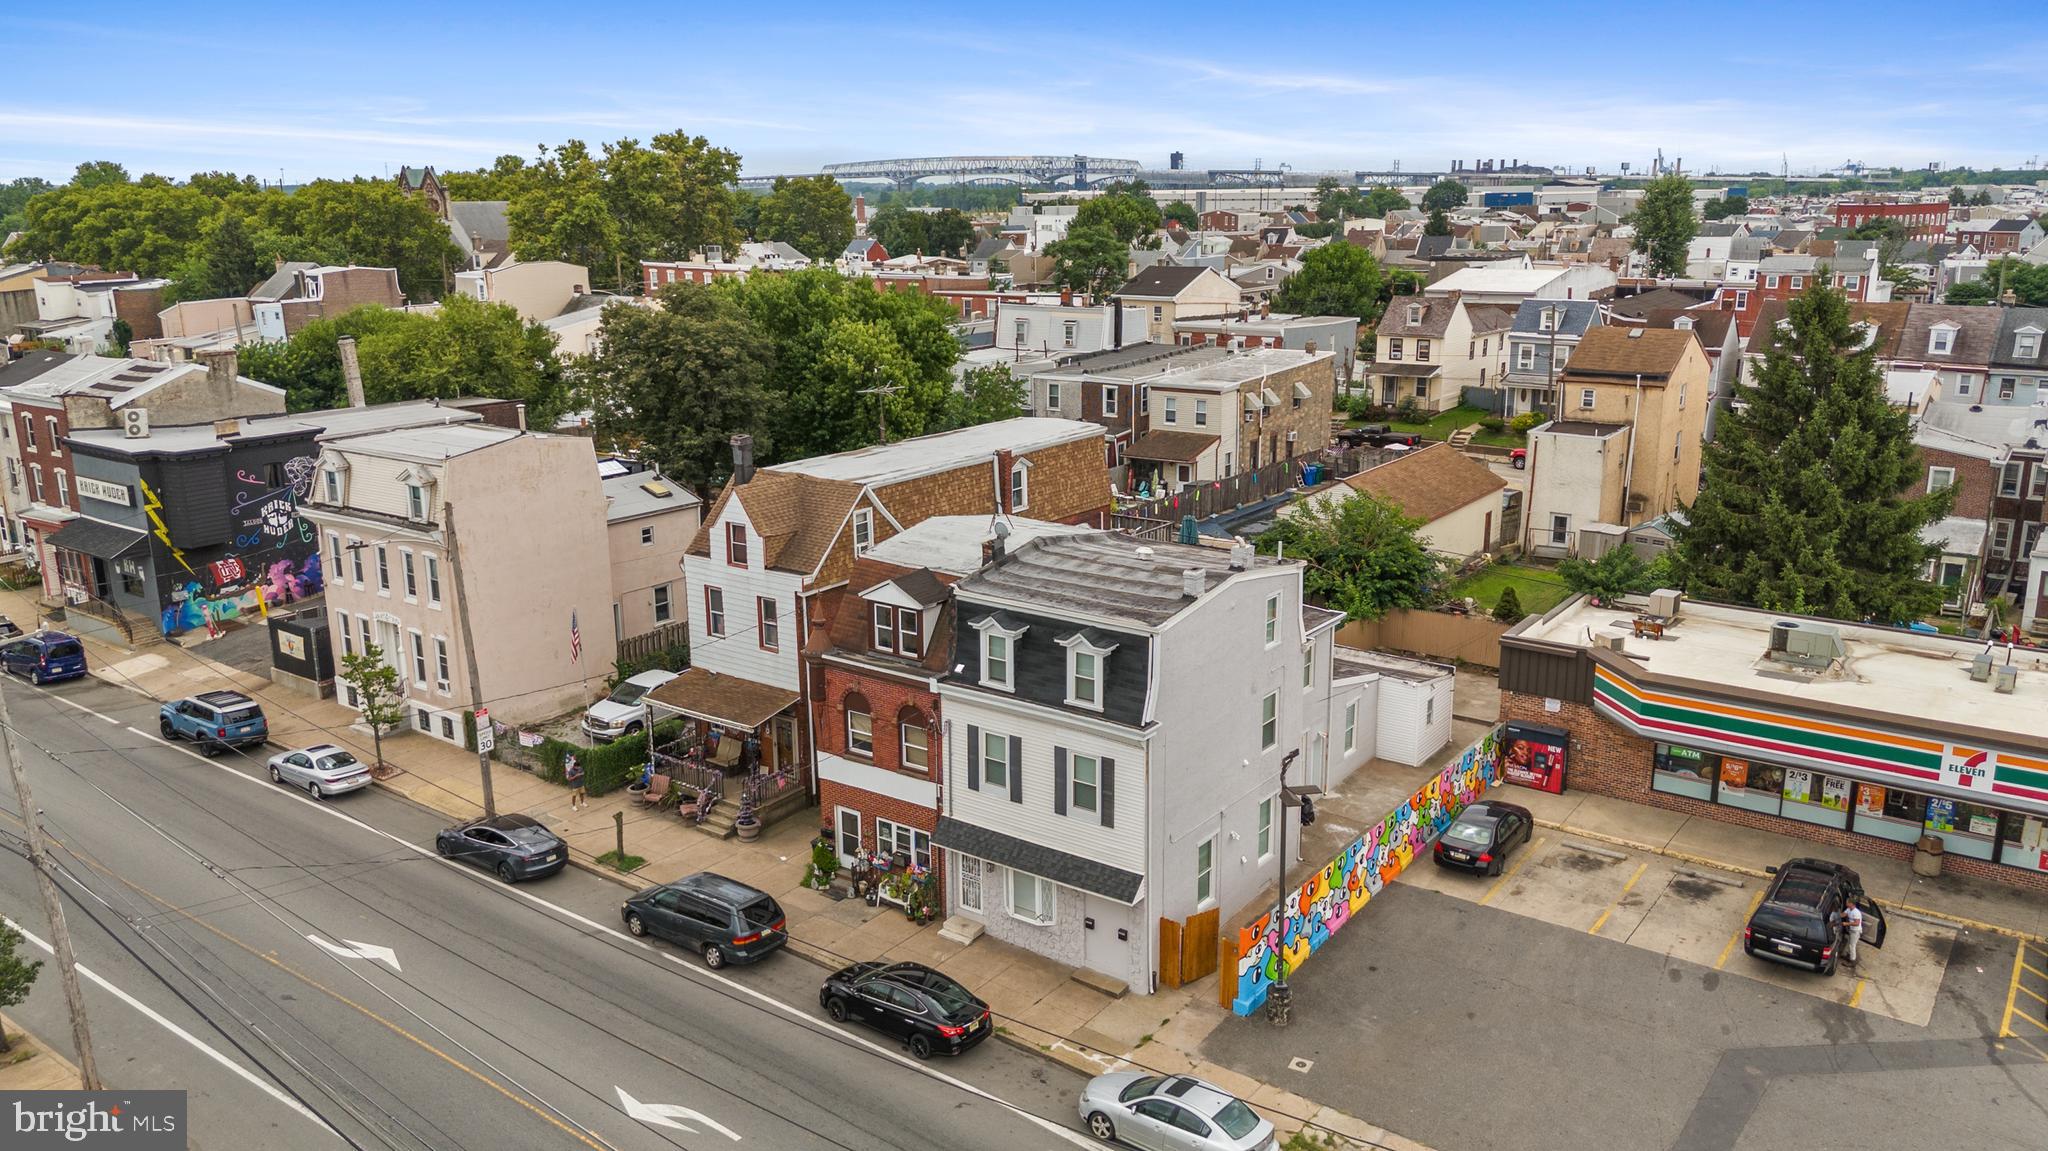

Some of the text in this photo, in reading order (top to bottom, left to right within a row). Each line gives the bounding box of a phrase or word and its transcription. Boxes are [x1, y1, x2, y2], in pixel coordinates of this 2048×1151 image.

[480, 739, 492, 751] 30
[1547, 744, 1563, 754] NEW
[1681, 749, 1700, 759] ATM
[1825, 780, 1845, 790] FREE
